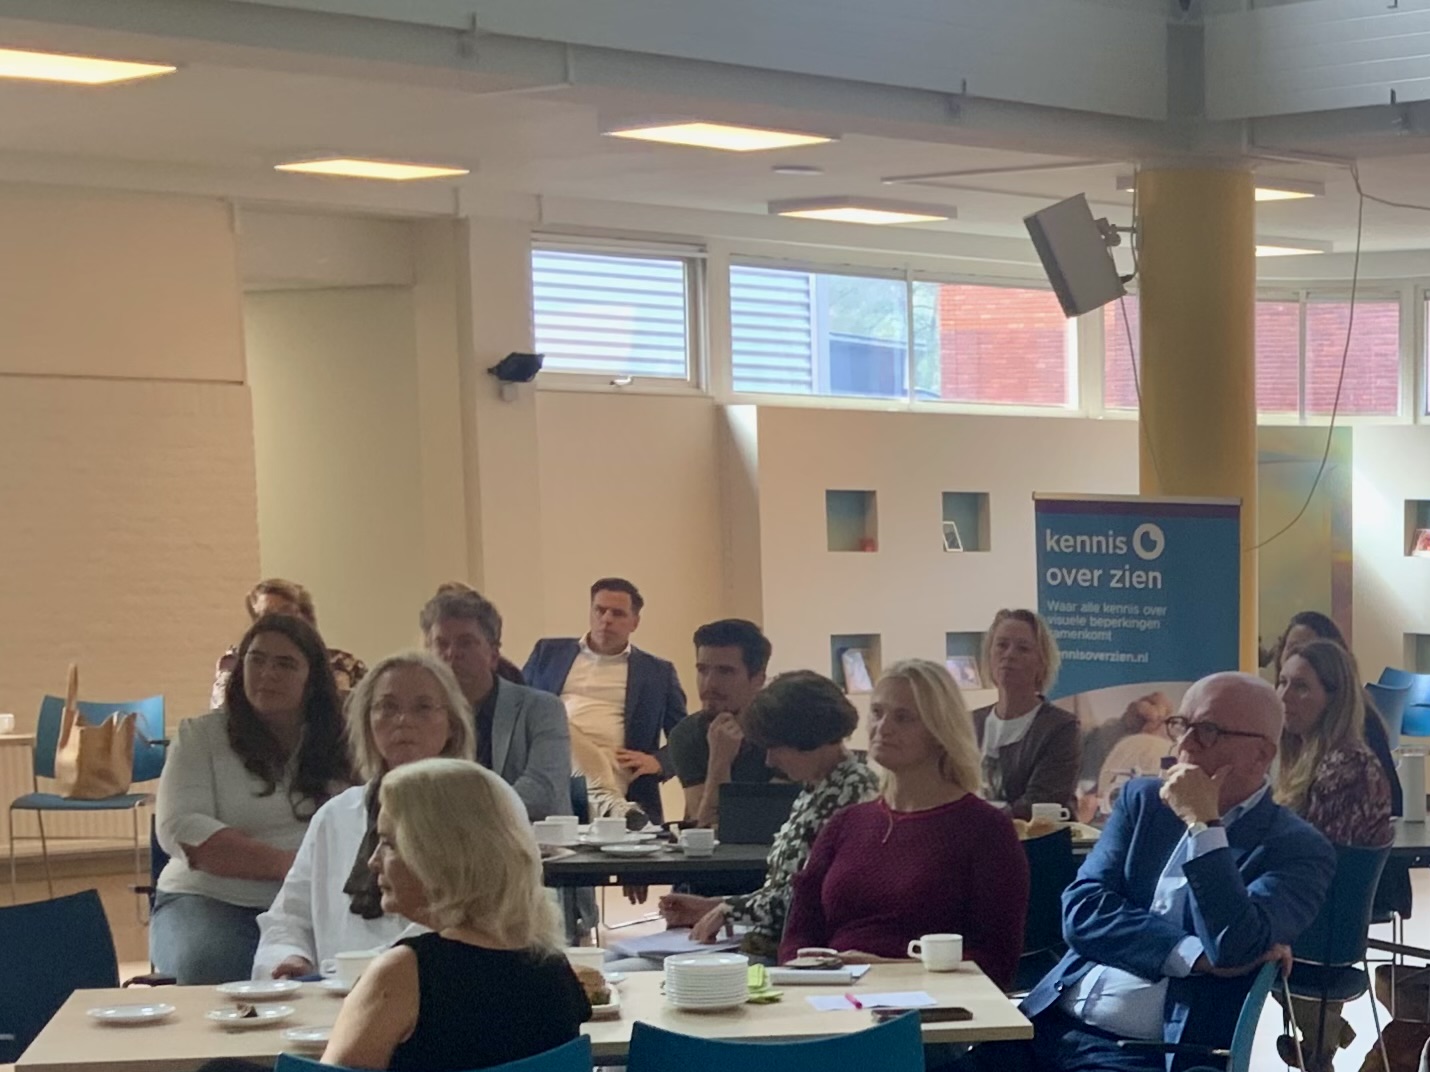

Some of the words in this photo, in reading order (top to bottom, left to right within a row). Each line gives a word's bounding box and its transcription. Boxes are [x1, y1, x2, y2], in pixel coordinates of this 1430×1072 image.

[1046, 529, 1128, 555] kennis
[1046, 568, 1103, 587] over
[1110, 564, 1162, 589] zien
[1047, 601, 1077, 613] Waar
[1080, 602, 1101, 613] alle
[1103, 602, 1140, 615] kennis
[1143, 606, 1167, 616] over
[1047, 615, 1086, 626] visuele
[1090, 616, 1161, 631] beperkingen
[1060, 650, 1148, 663] nnisoverzien.nl
